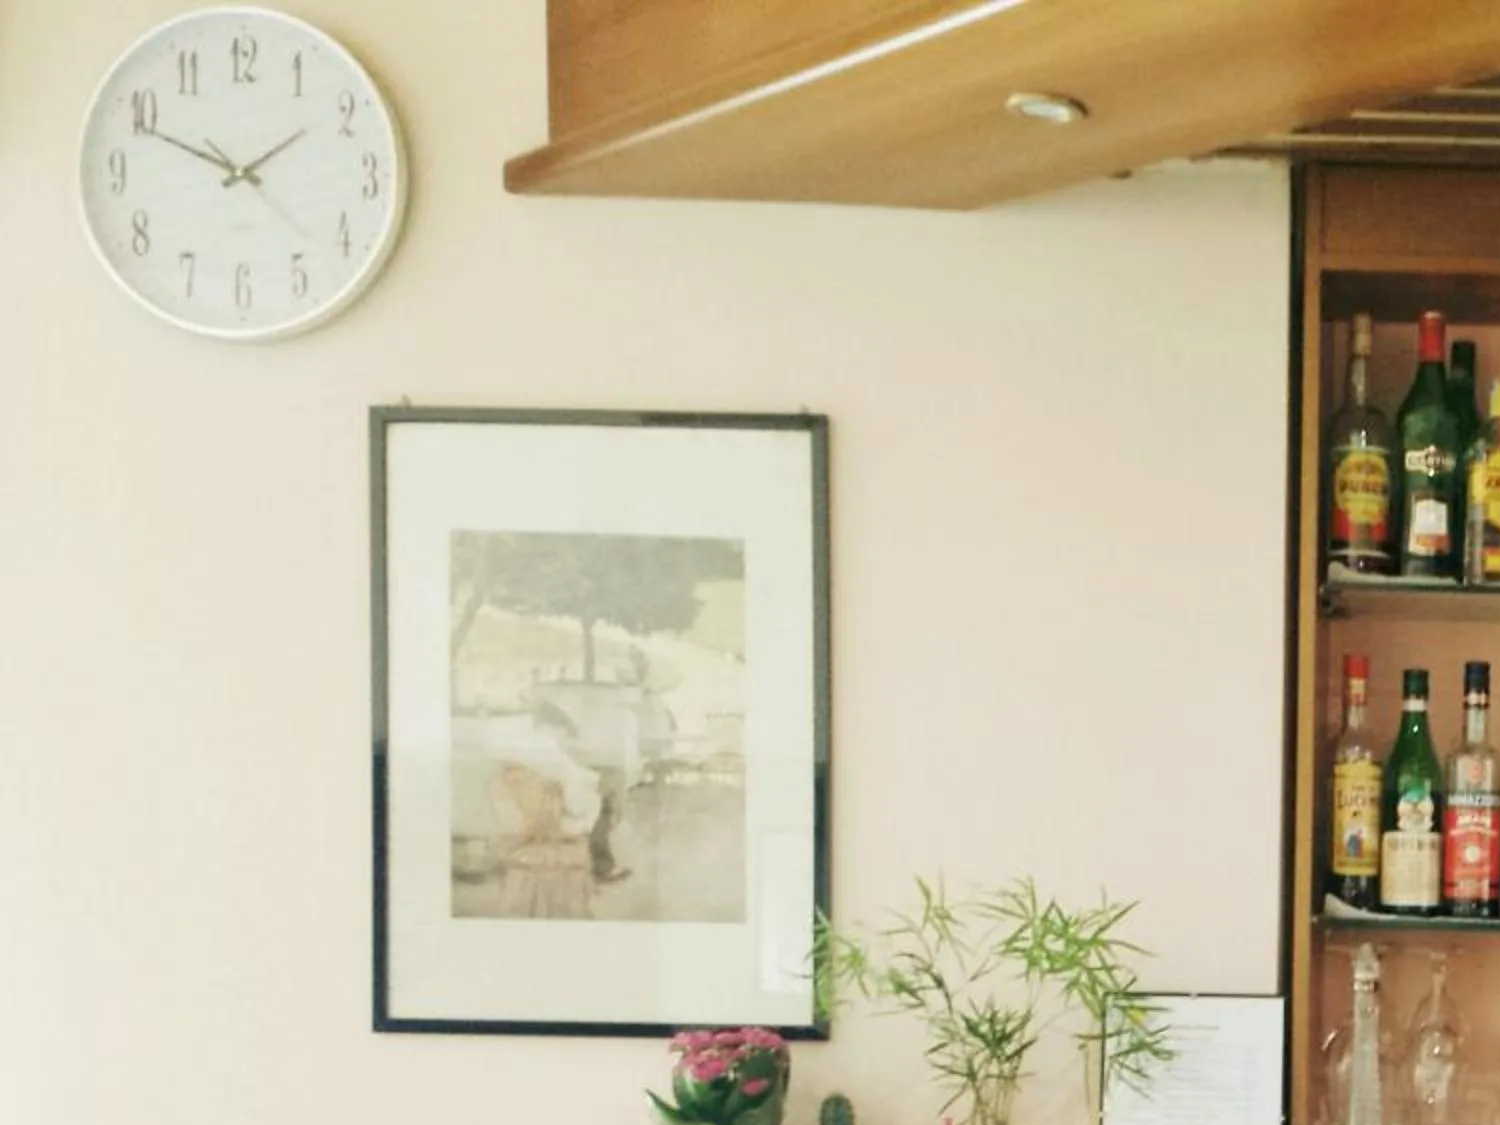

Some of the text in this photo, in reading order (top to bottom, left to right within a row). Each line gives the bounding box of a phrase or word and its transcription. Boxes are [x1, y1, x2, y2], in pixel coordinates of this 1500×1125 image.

[178, 49, 198, 96] 11
[230, 35, 258, 84] 12
[292, 49, 302, 98] 1
[131, 88, 158, 136] 10
[337, 89, 355, 138] 2
[108, 149, 127, 195] 9
[361, 151, 379, 200] 3
[131, 208, 150, 257] 8
[335, 210, 352, 258] 4
[178, 252, 195, 298] 7
[234, 261, 252, 312] 6
[291, 252, 308, 299] 5
